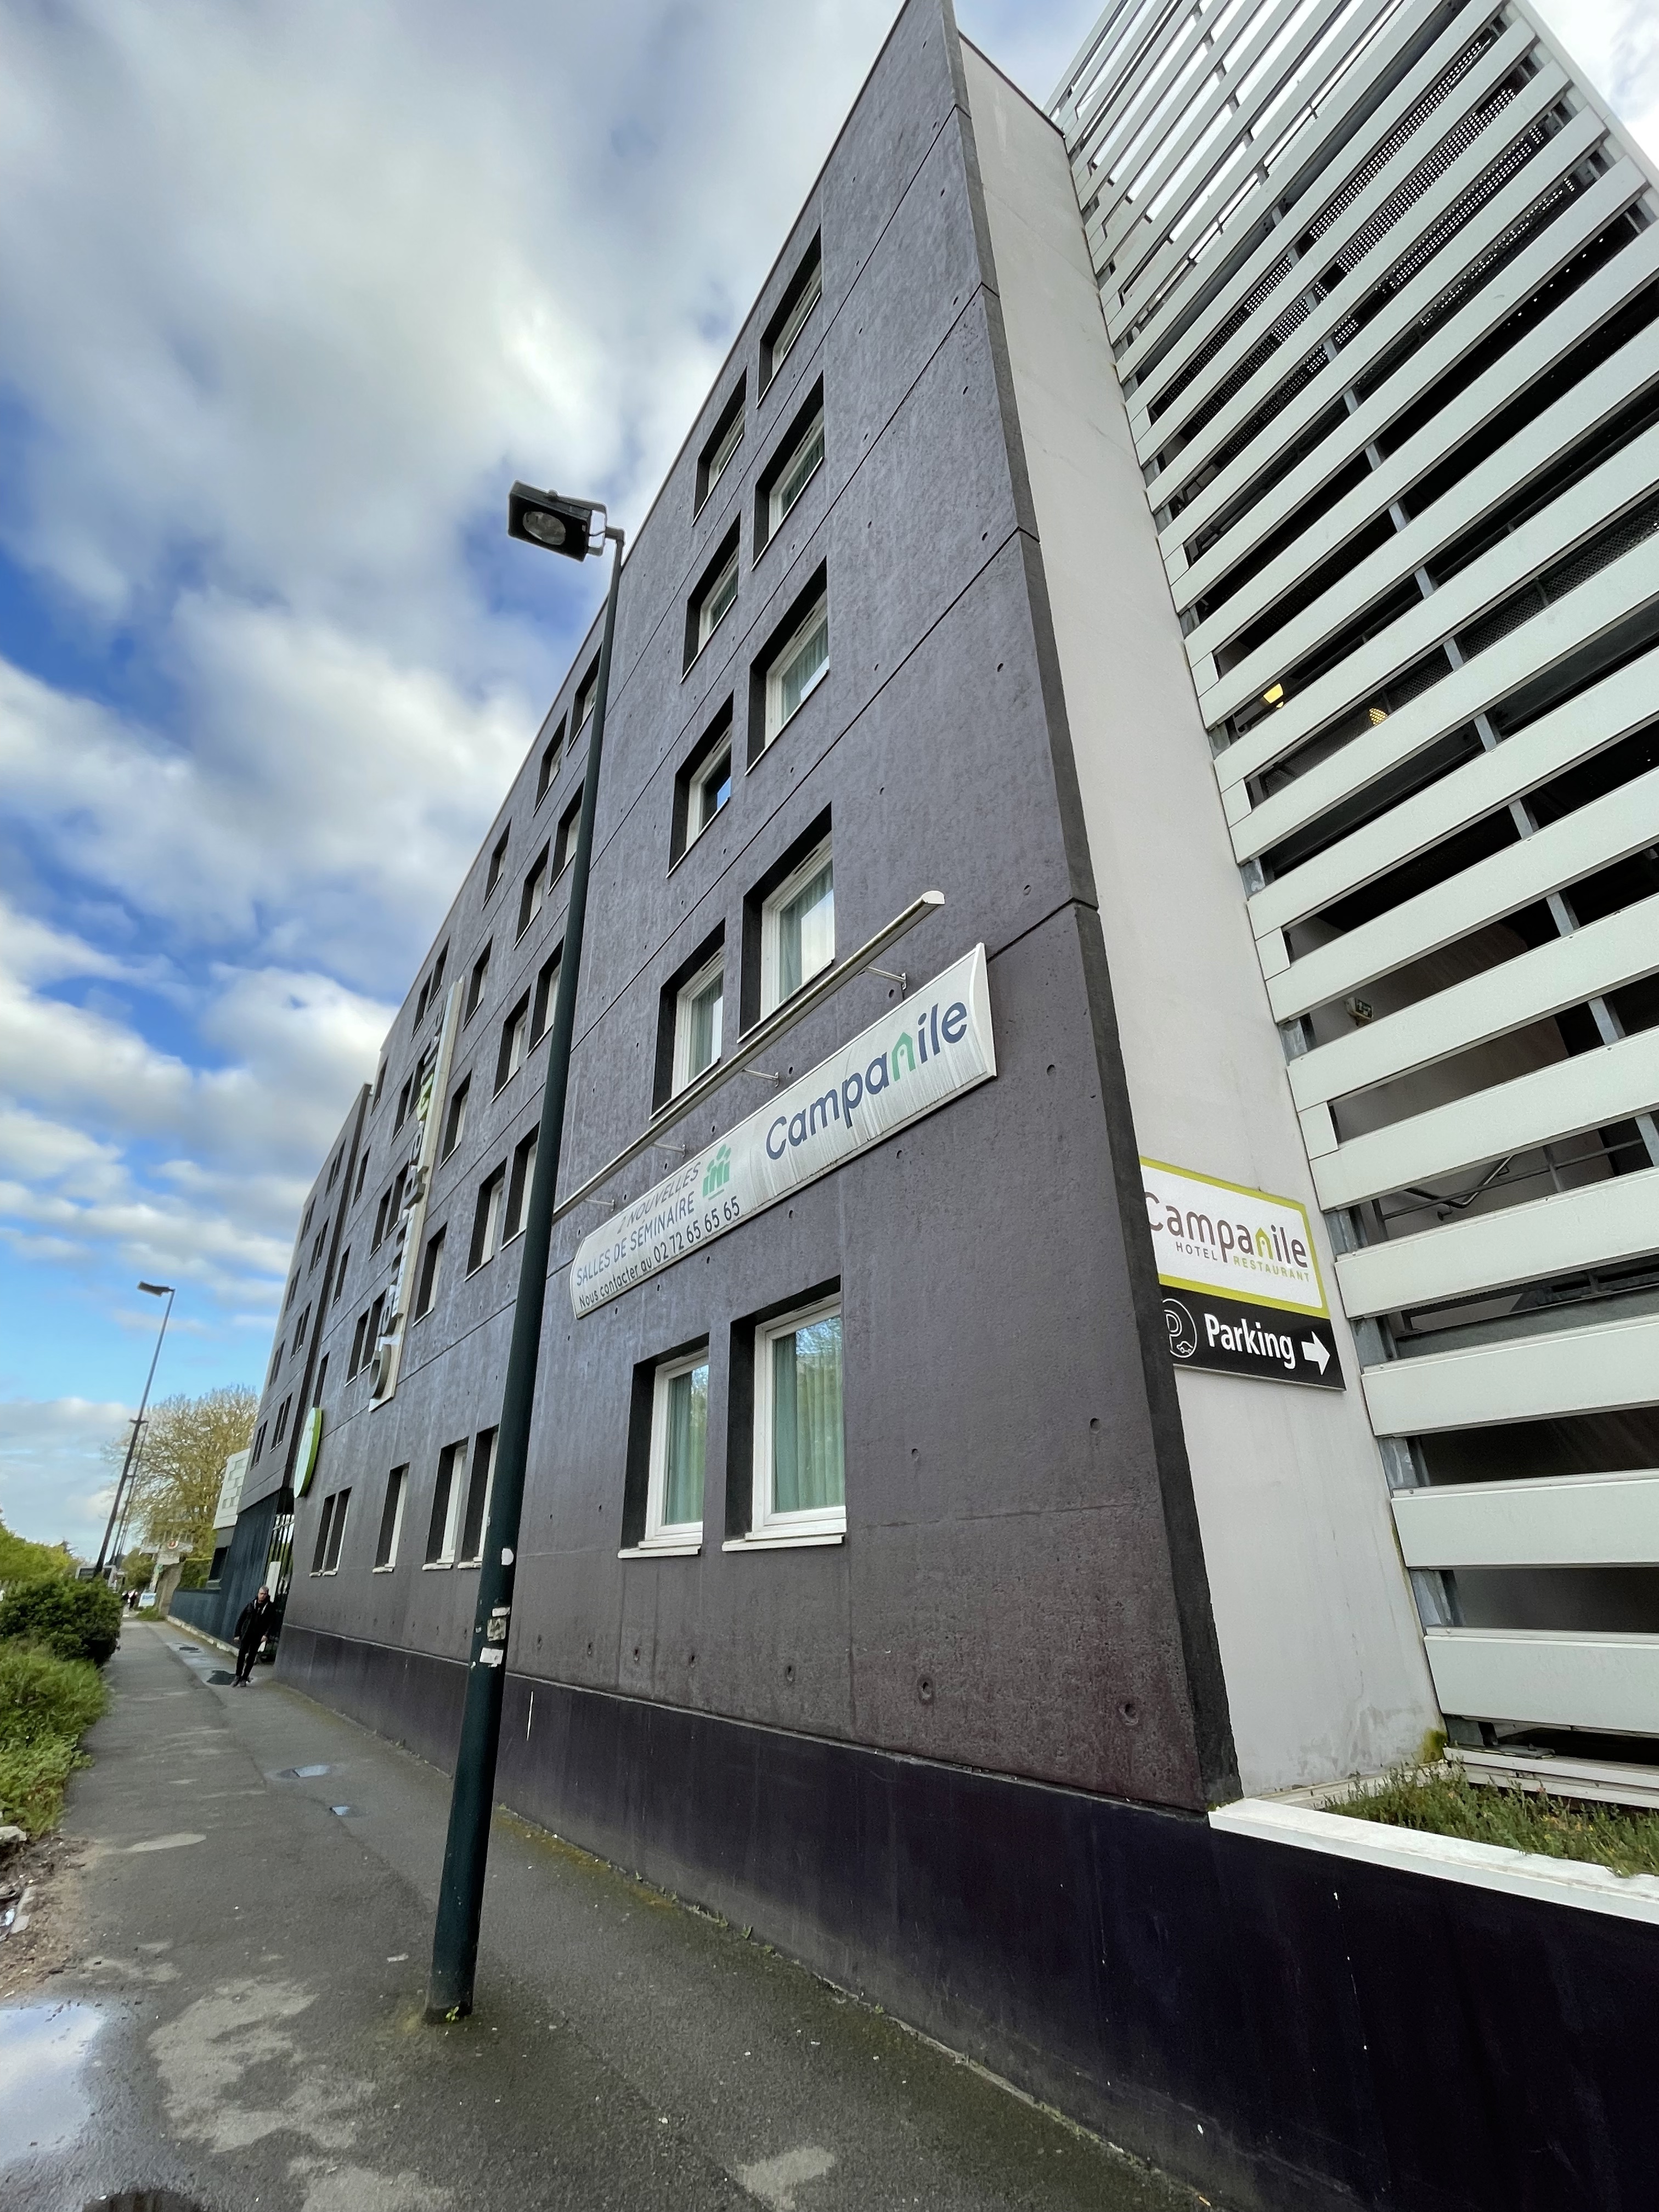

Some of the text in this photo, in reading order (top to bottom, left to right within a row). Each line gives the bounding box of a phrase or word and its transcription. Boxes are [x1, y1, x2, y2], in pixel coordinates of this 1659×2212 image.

[766, 1002, 967, 1160] Campanile
[627, 1161, 701, 1227] NOUVELLES
[577, 1190, 695, 1286] SALLES DE SÉMINAIRE
[579, 1195, 740, 1309] Nous contacter au 02 72 65 65 65
[1176, 1242, 1310, 1283] HOTEL RESTAURANT
[1204, 1313, 1296, 1370] Parking
